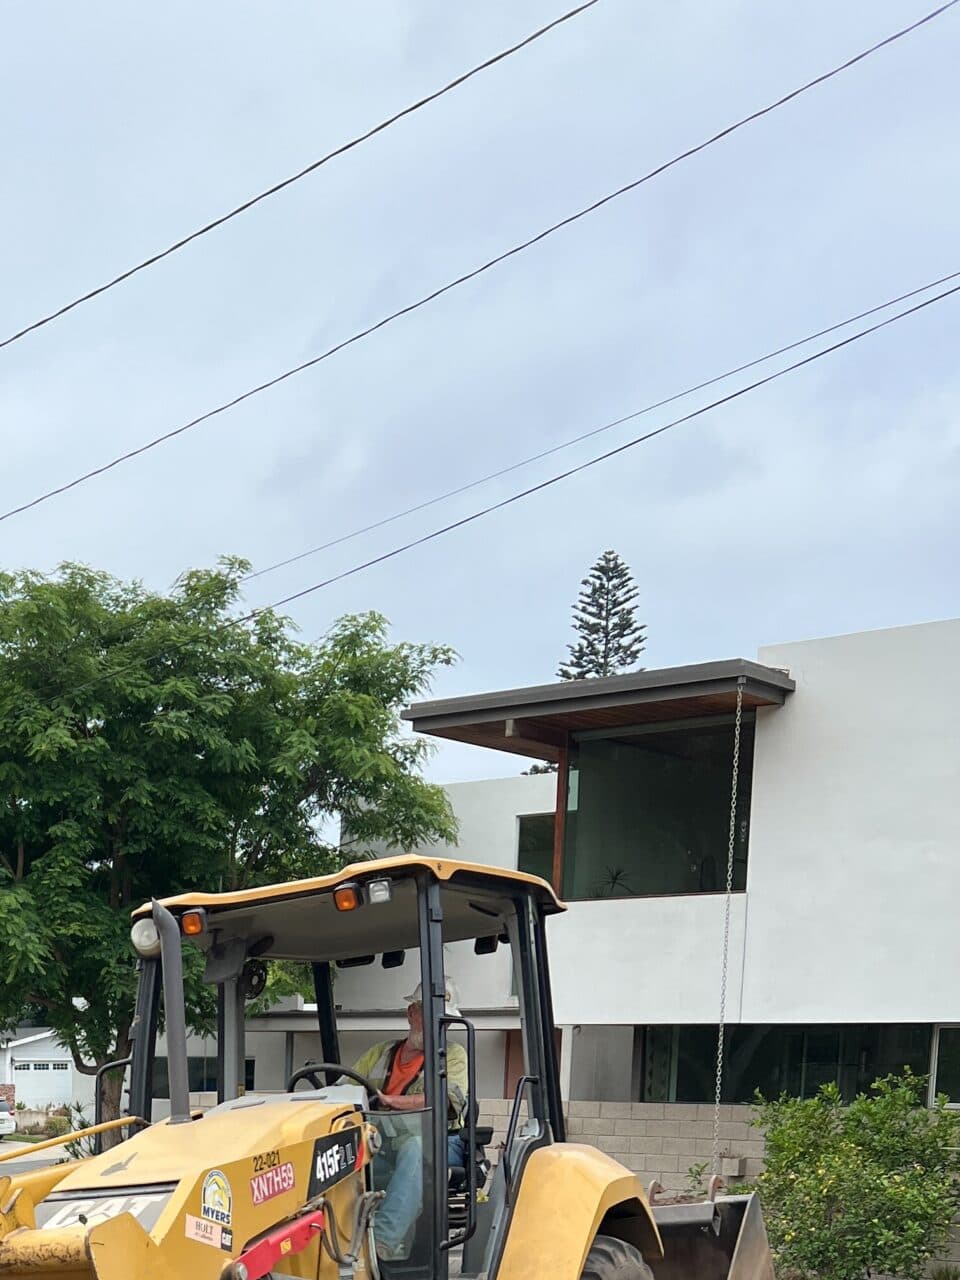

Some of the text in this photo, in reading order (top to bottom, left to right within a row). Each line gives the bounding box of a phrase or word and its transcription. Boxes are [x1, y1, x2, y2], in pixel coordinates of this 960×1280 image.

[253, 1149, 280, 1172] 22-021
[251, 1163, 294, 1203] XN7H59
[202, 1205, 231, 1225] MYERS
[195, 1220, 214, 1236] HOLT
